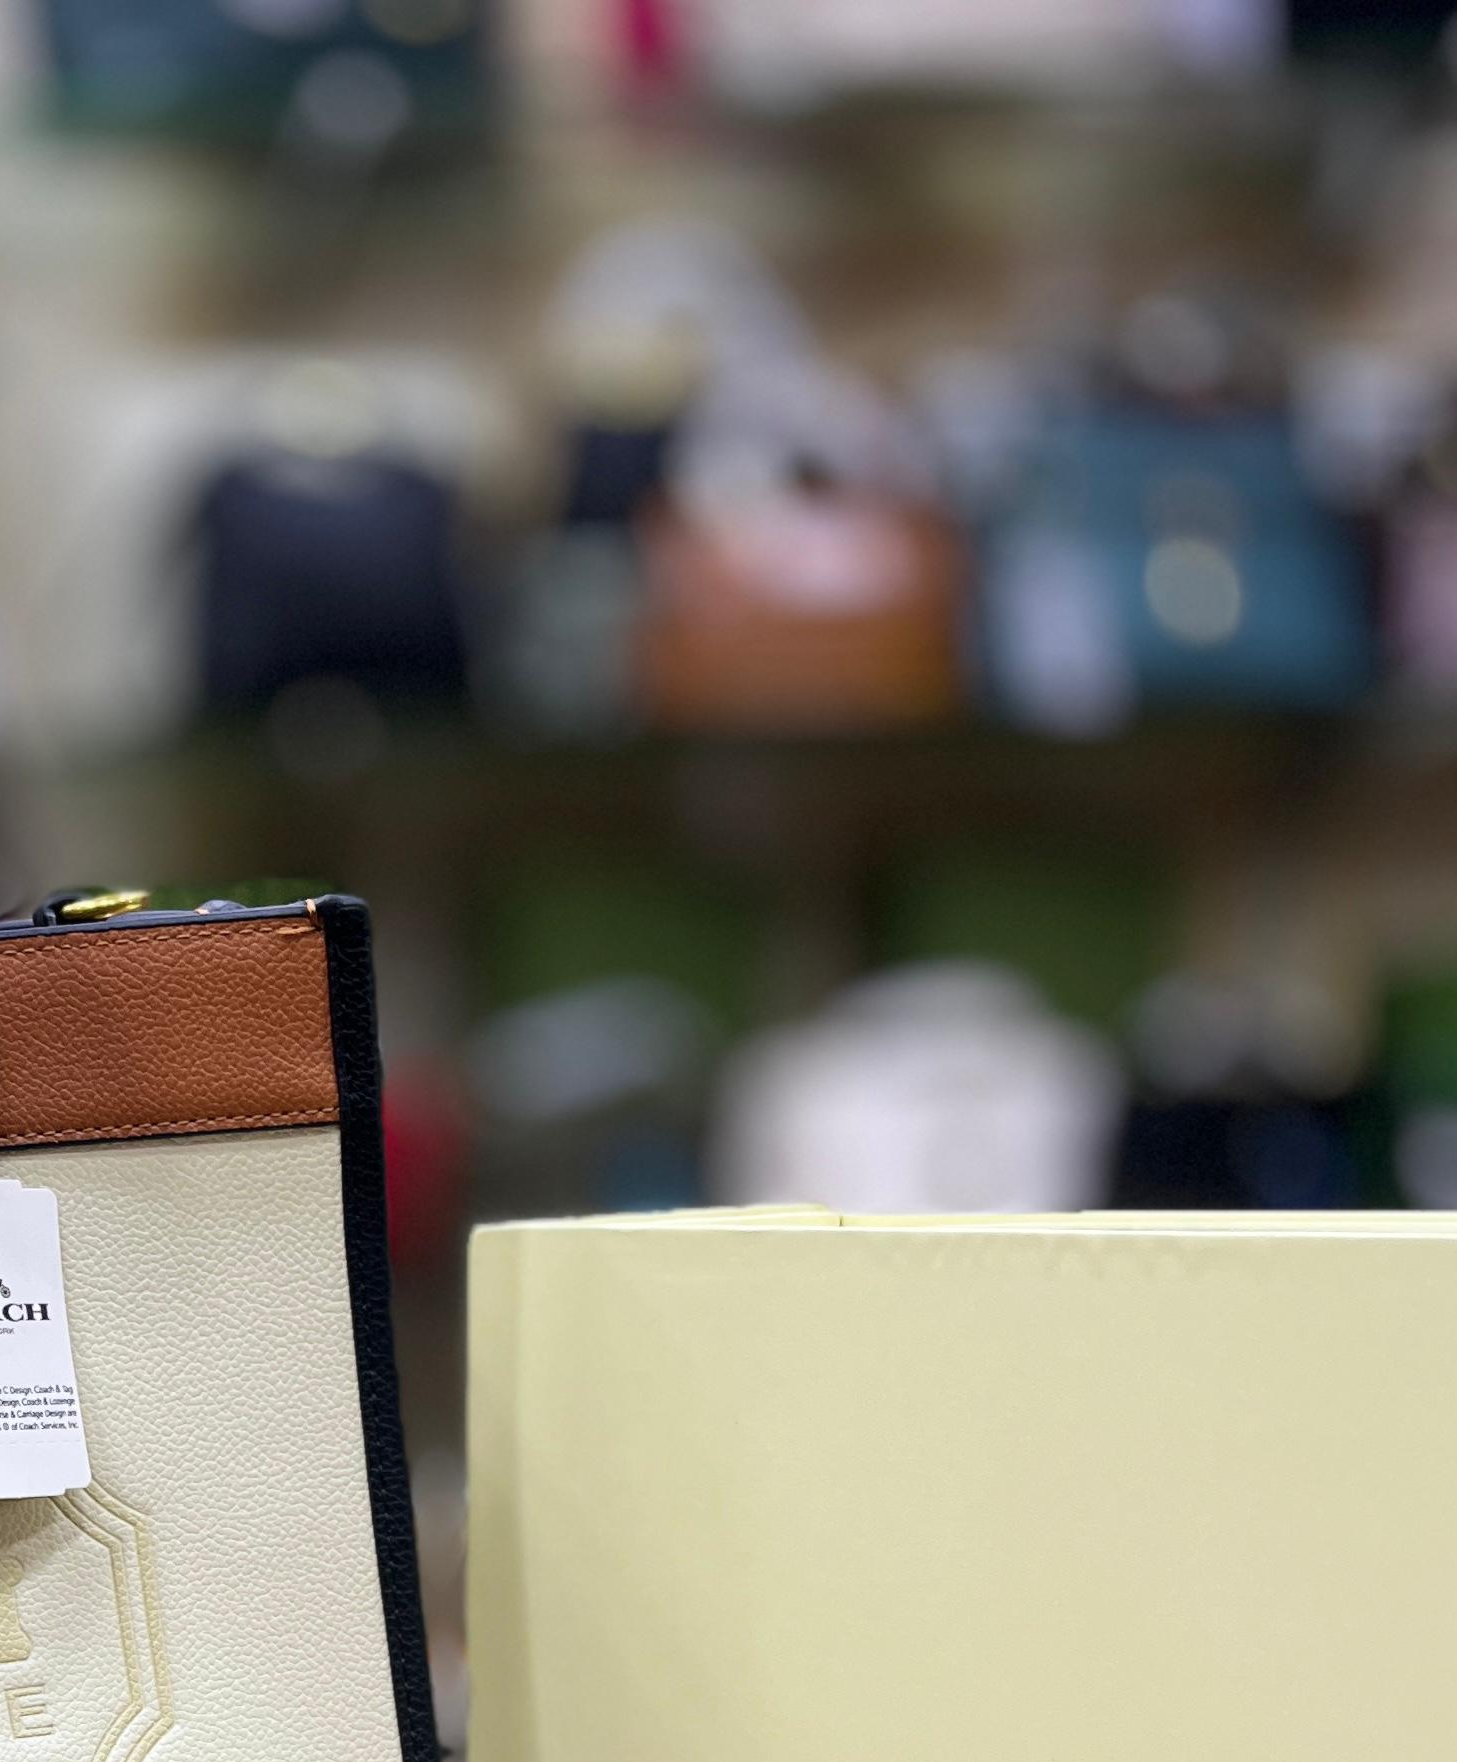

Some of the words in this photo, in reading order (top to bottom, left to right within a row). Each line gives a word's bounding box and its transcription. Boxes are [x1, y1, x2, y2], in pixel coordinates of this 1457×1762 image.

[3, 1386, 9, 1394] C
[34, 1385, 54, 1393] Coach
[22, 1398, 42, 1406] Coach
[19, 1422, 39, 1430] Coach
